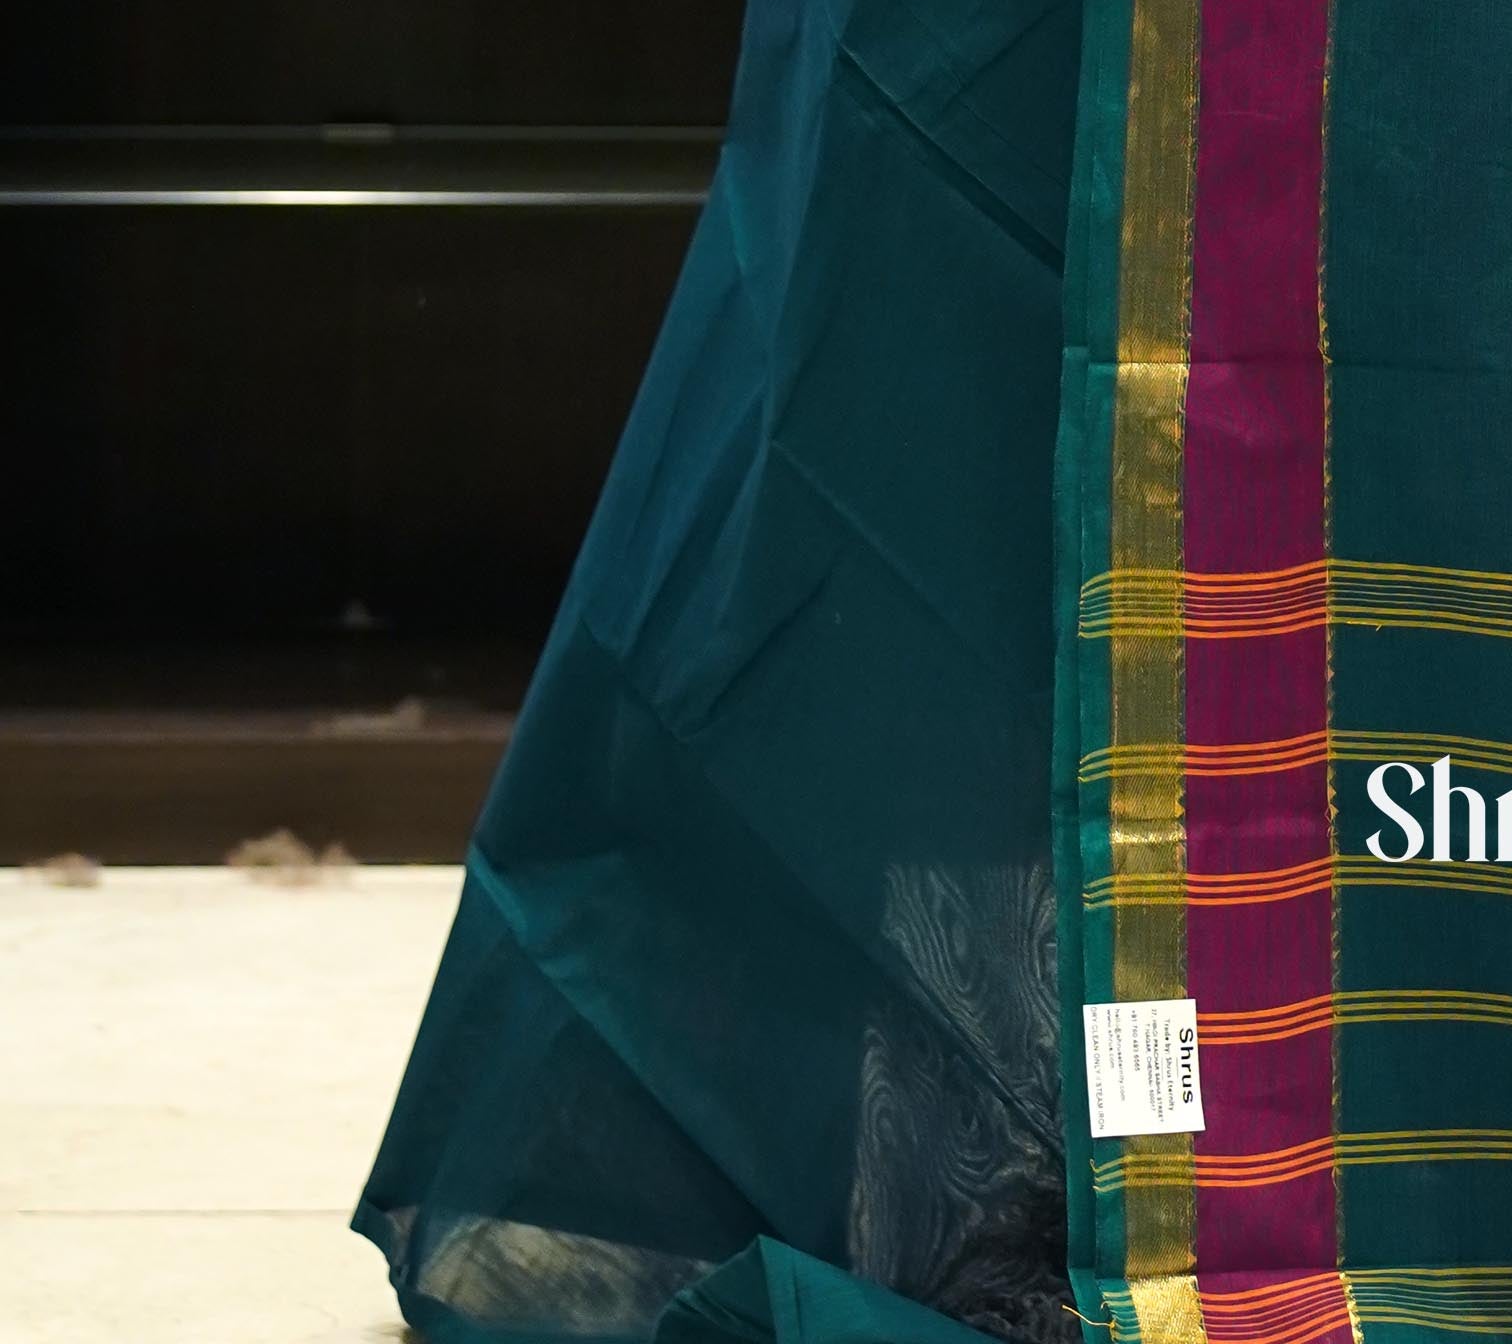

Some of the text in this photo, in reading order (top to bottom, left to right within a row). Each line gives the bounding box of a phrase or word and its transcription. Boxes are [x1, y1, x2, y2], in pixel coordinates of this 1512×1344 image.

[1091, 1025, 1100, 1052] CLEAN
[1164, 1017, 1172, 1041] Trade
[1179, 1028, 1194, 1104] Shrus
